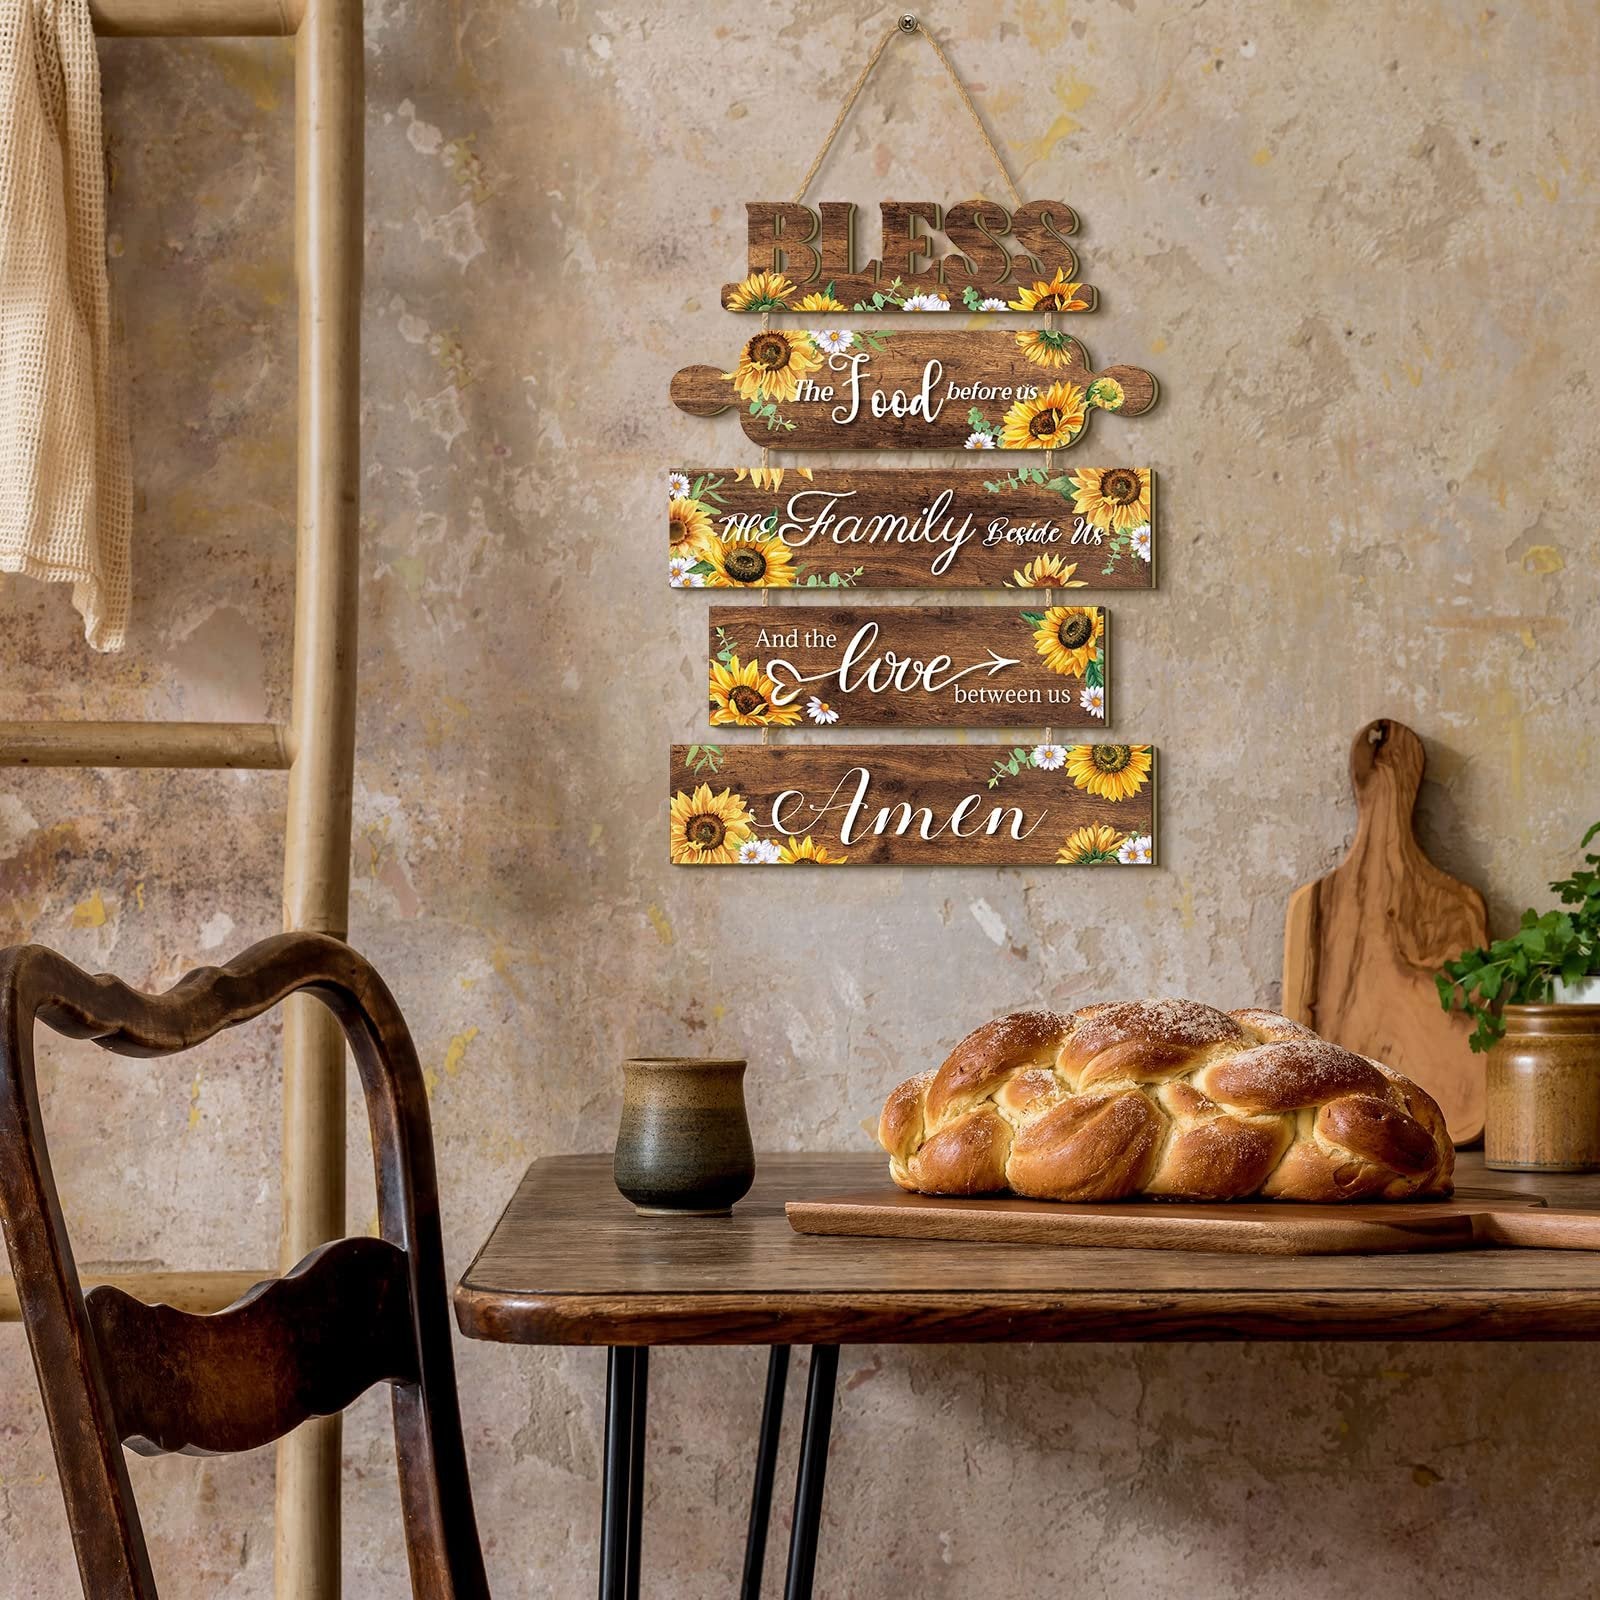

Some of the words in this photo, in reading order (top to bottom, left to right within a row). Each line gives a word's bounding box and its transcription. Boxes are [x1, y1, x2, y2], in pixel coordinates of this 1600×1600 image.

[745, 200, 1080, 285] BLESS
[793, 379, 834, 402] The
[828, 352, 944, 425] Food
[946, 382, 1012, 400] before
[778, 489, 977, 577] Family
[982, 516, 1062, 547] Beside
[1070, 516, 1106, 546] Us
[755, 628, 798, 648] And
[804, 628, 837, 648] the
[838, 621, 953, 693] love
[953, 683, 1041, 703] between
[1048, 688, 1071, 703] us
[750, 766, 1049, 846] Amen
